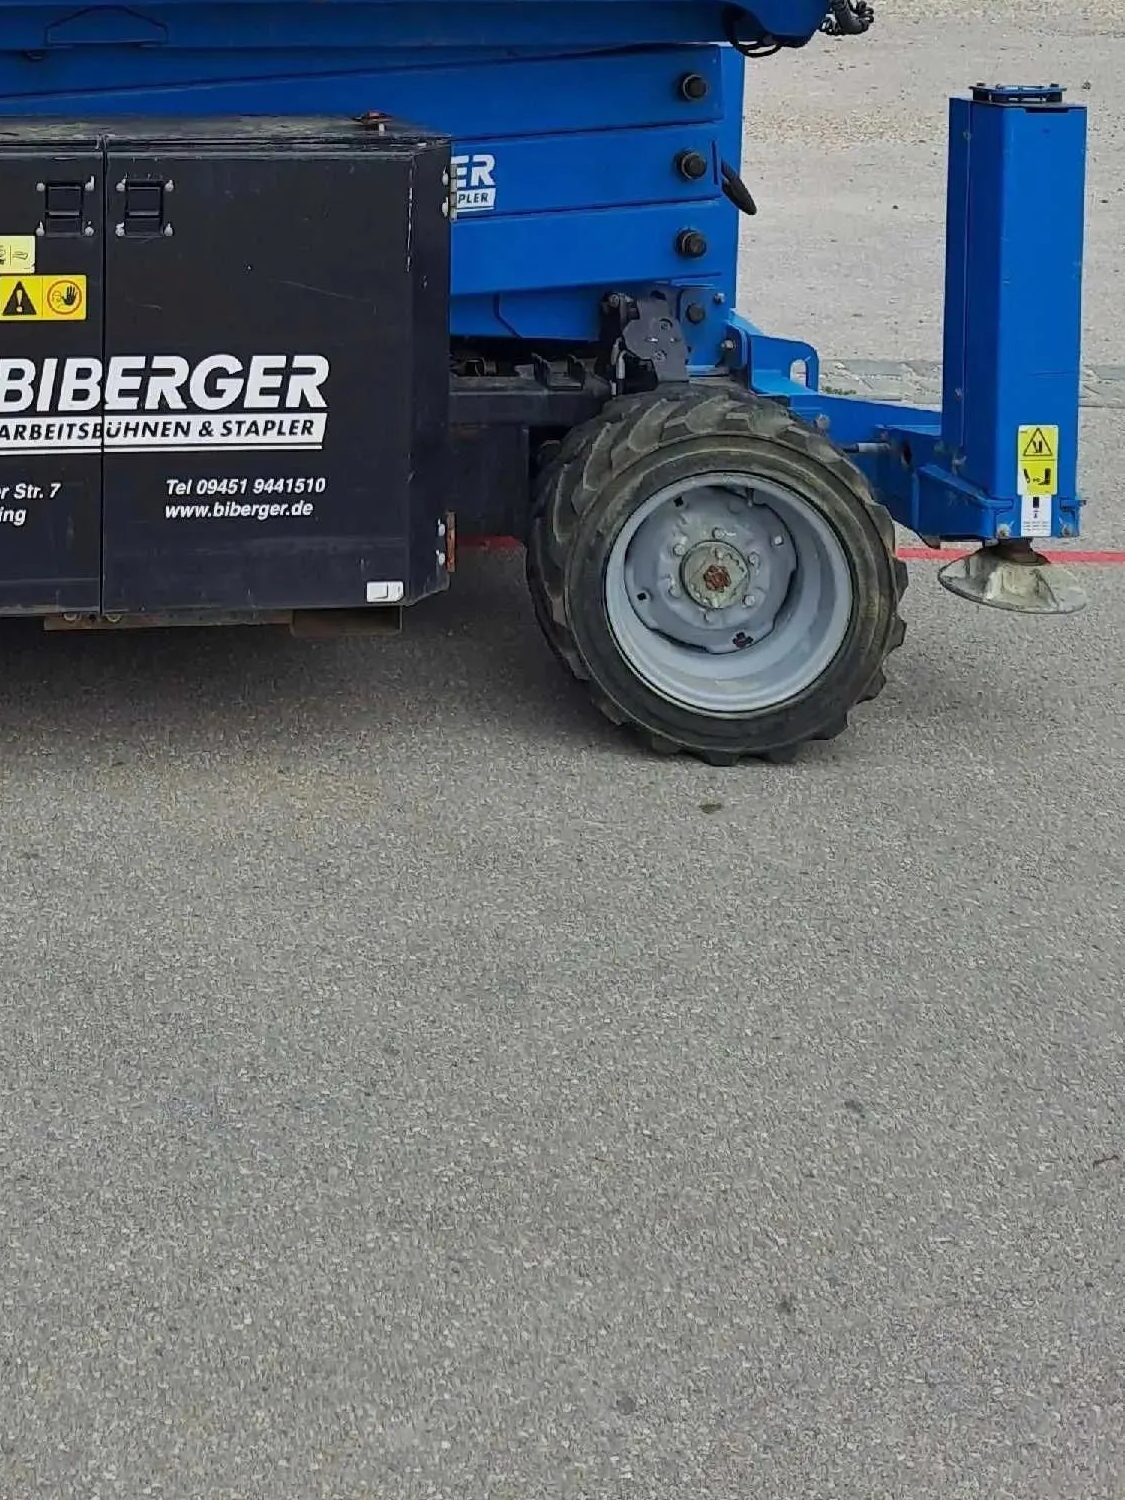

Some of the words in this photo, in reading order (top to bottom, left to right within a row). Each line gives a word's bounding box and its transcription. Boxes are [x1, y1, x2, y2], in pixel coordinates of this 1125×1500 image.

[198, 421, 214, 438] &
[219, 418, 315, 438] STAPLER
[13, 482, 44, 499] Str.
[49, 482, 62, 499] 7
[166, 479, 193, 495] Tel
[196, 479, 248, 495] 09451
[252, 477, 326, 494] 9441510
[165, 499, 314, 521] www.biberger.de
